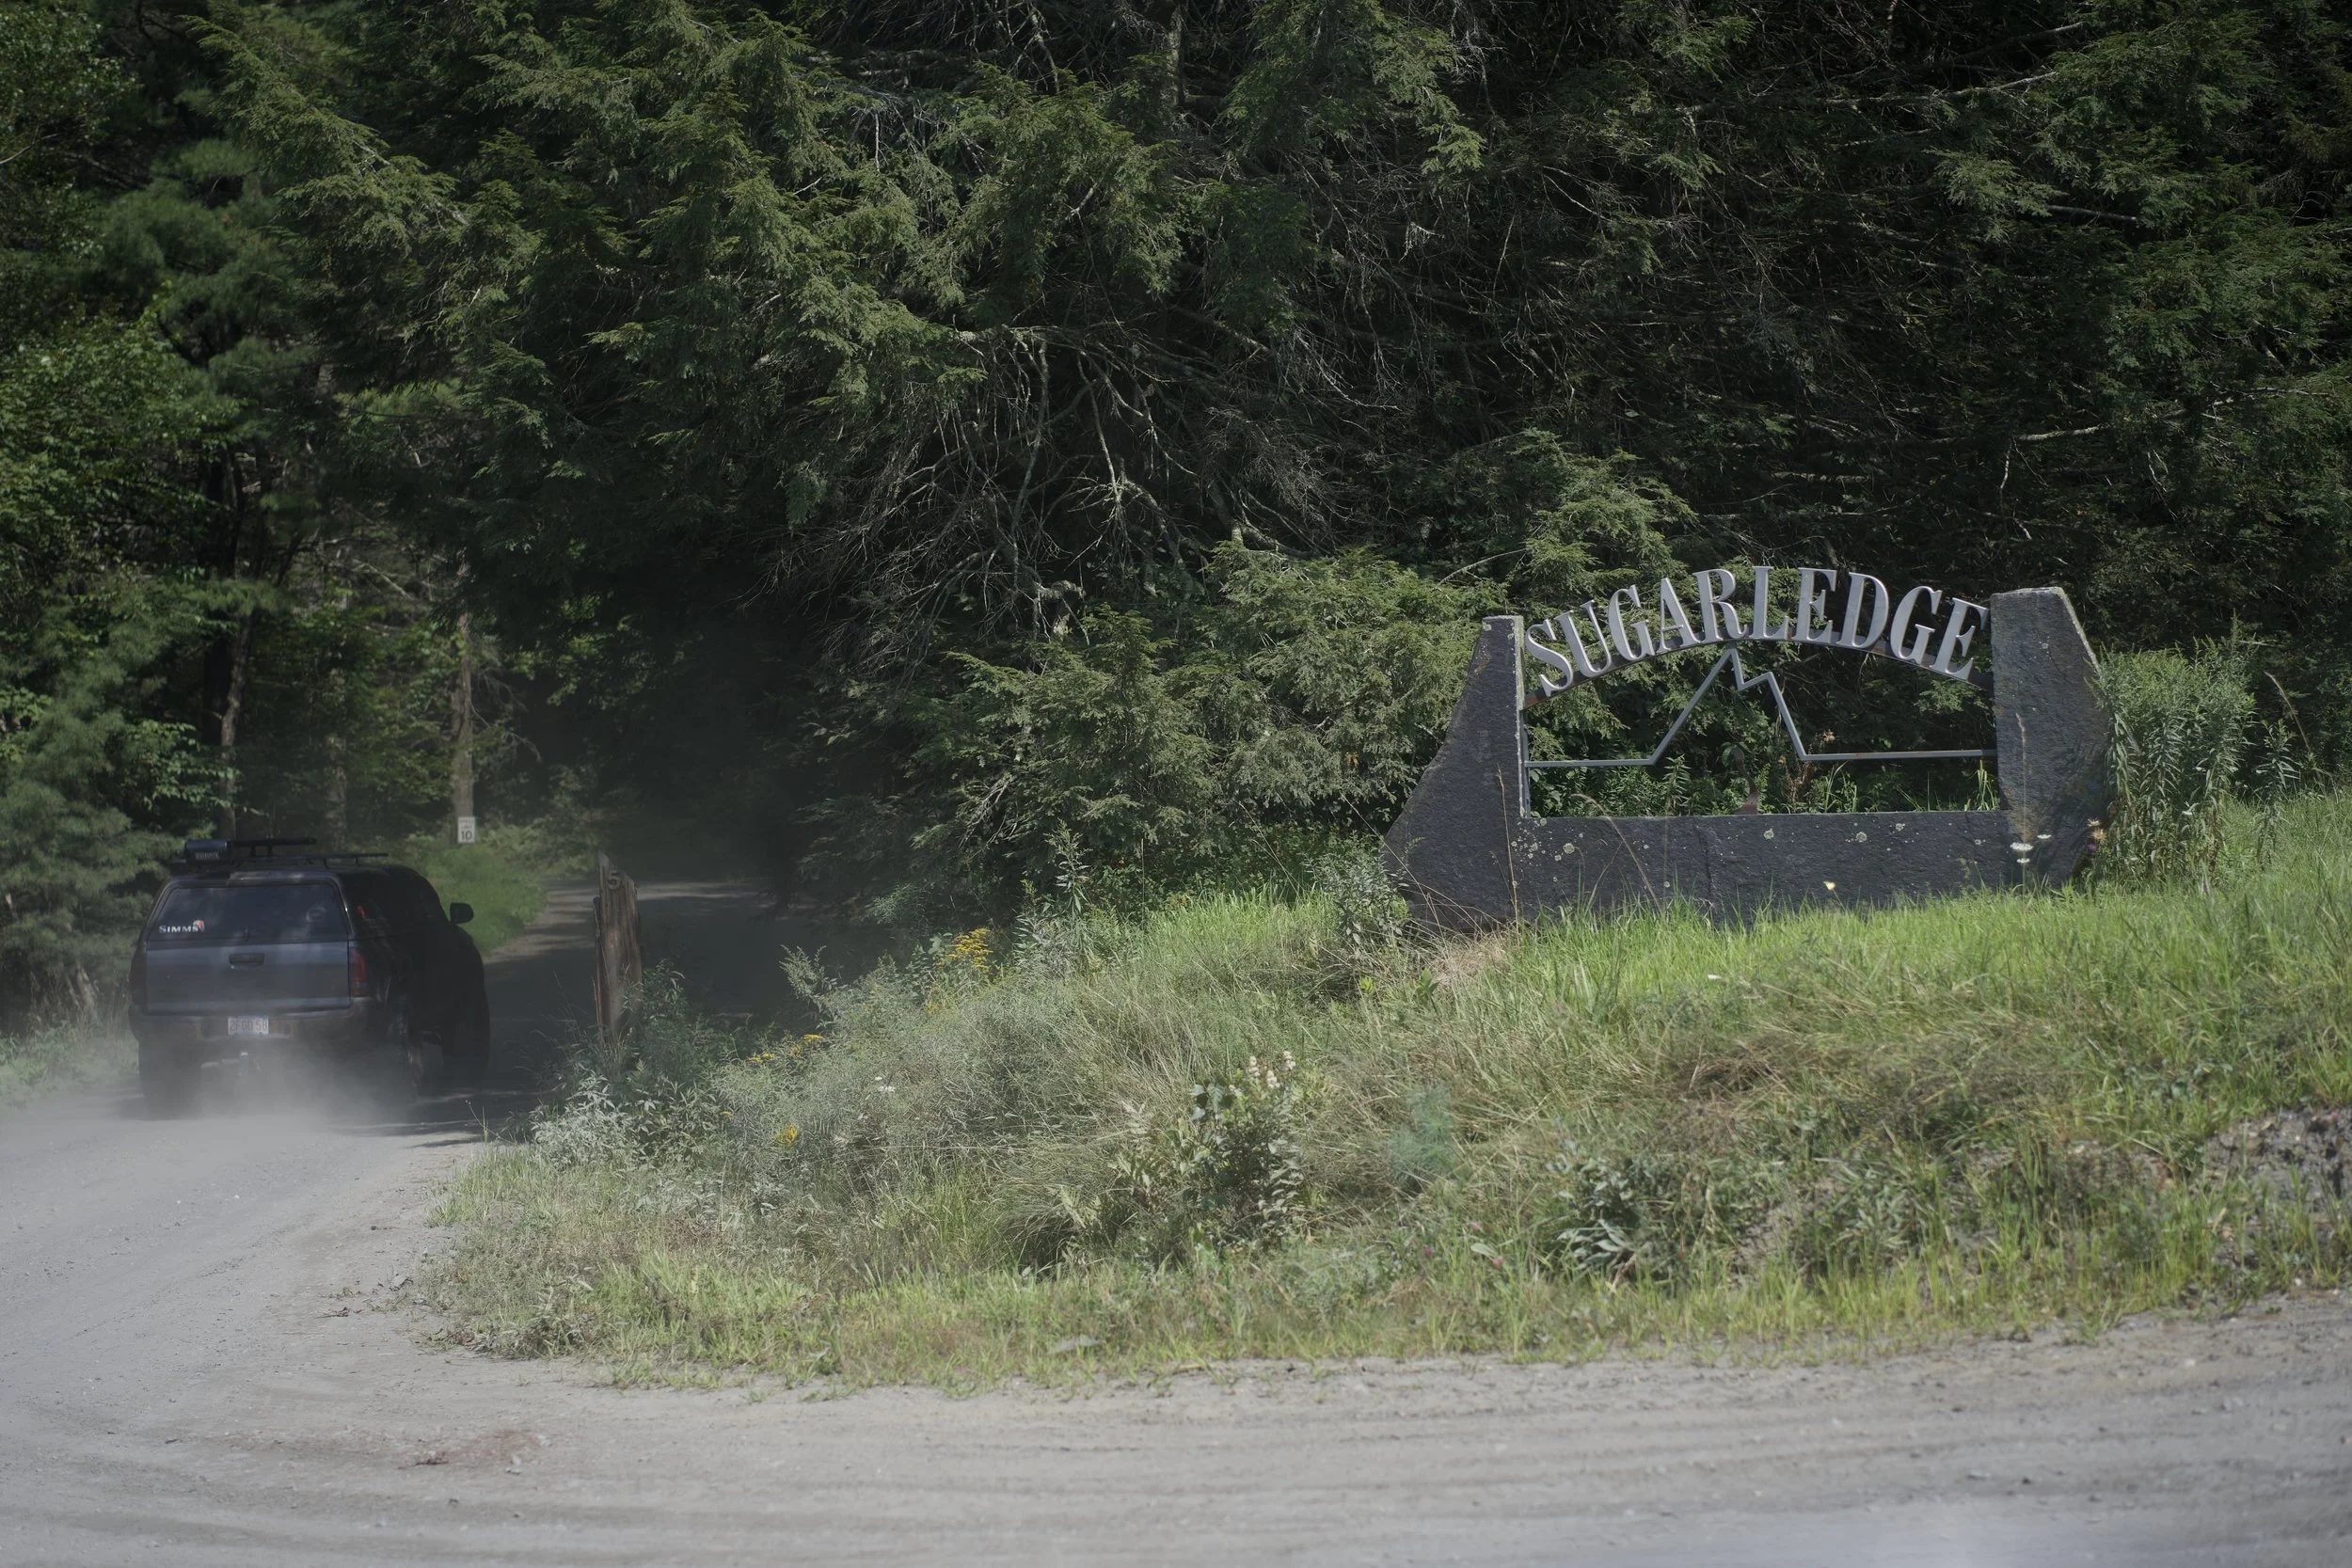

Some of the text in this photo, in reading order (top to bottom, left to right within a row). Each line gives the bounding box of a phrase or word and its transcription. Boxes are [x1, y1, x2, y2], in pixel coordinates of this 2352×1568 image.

[1525, 565, 1990, 698] SUGARLEDGE
[461, 831, 472, 840] 10
[608, 870, 621, 890] 5
[158, 925, 199, 933] SIMMS
